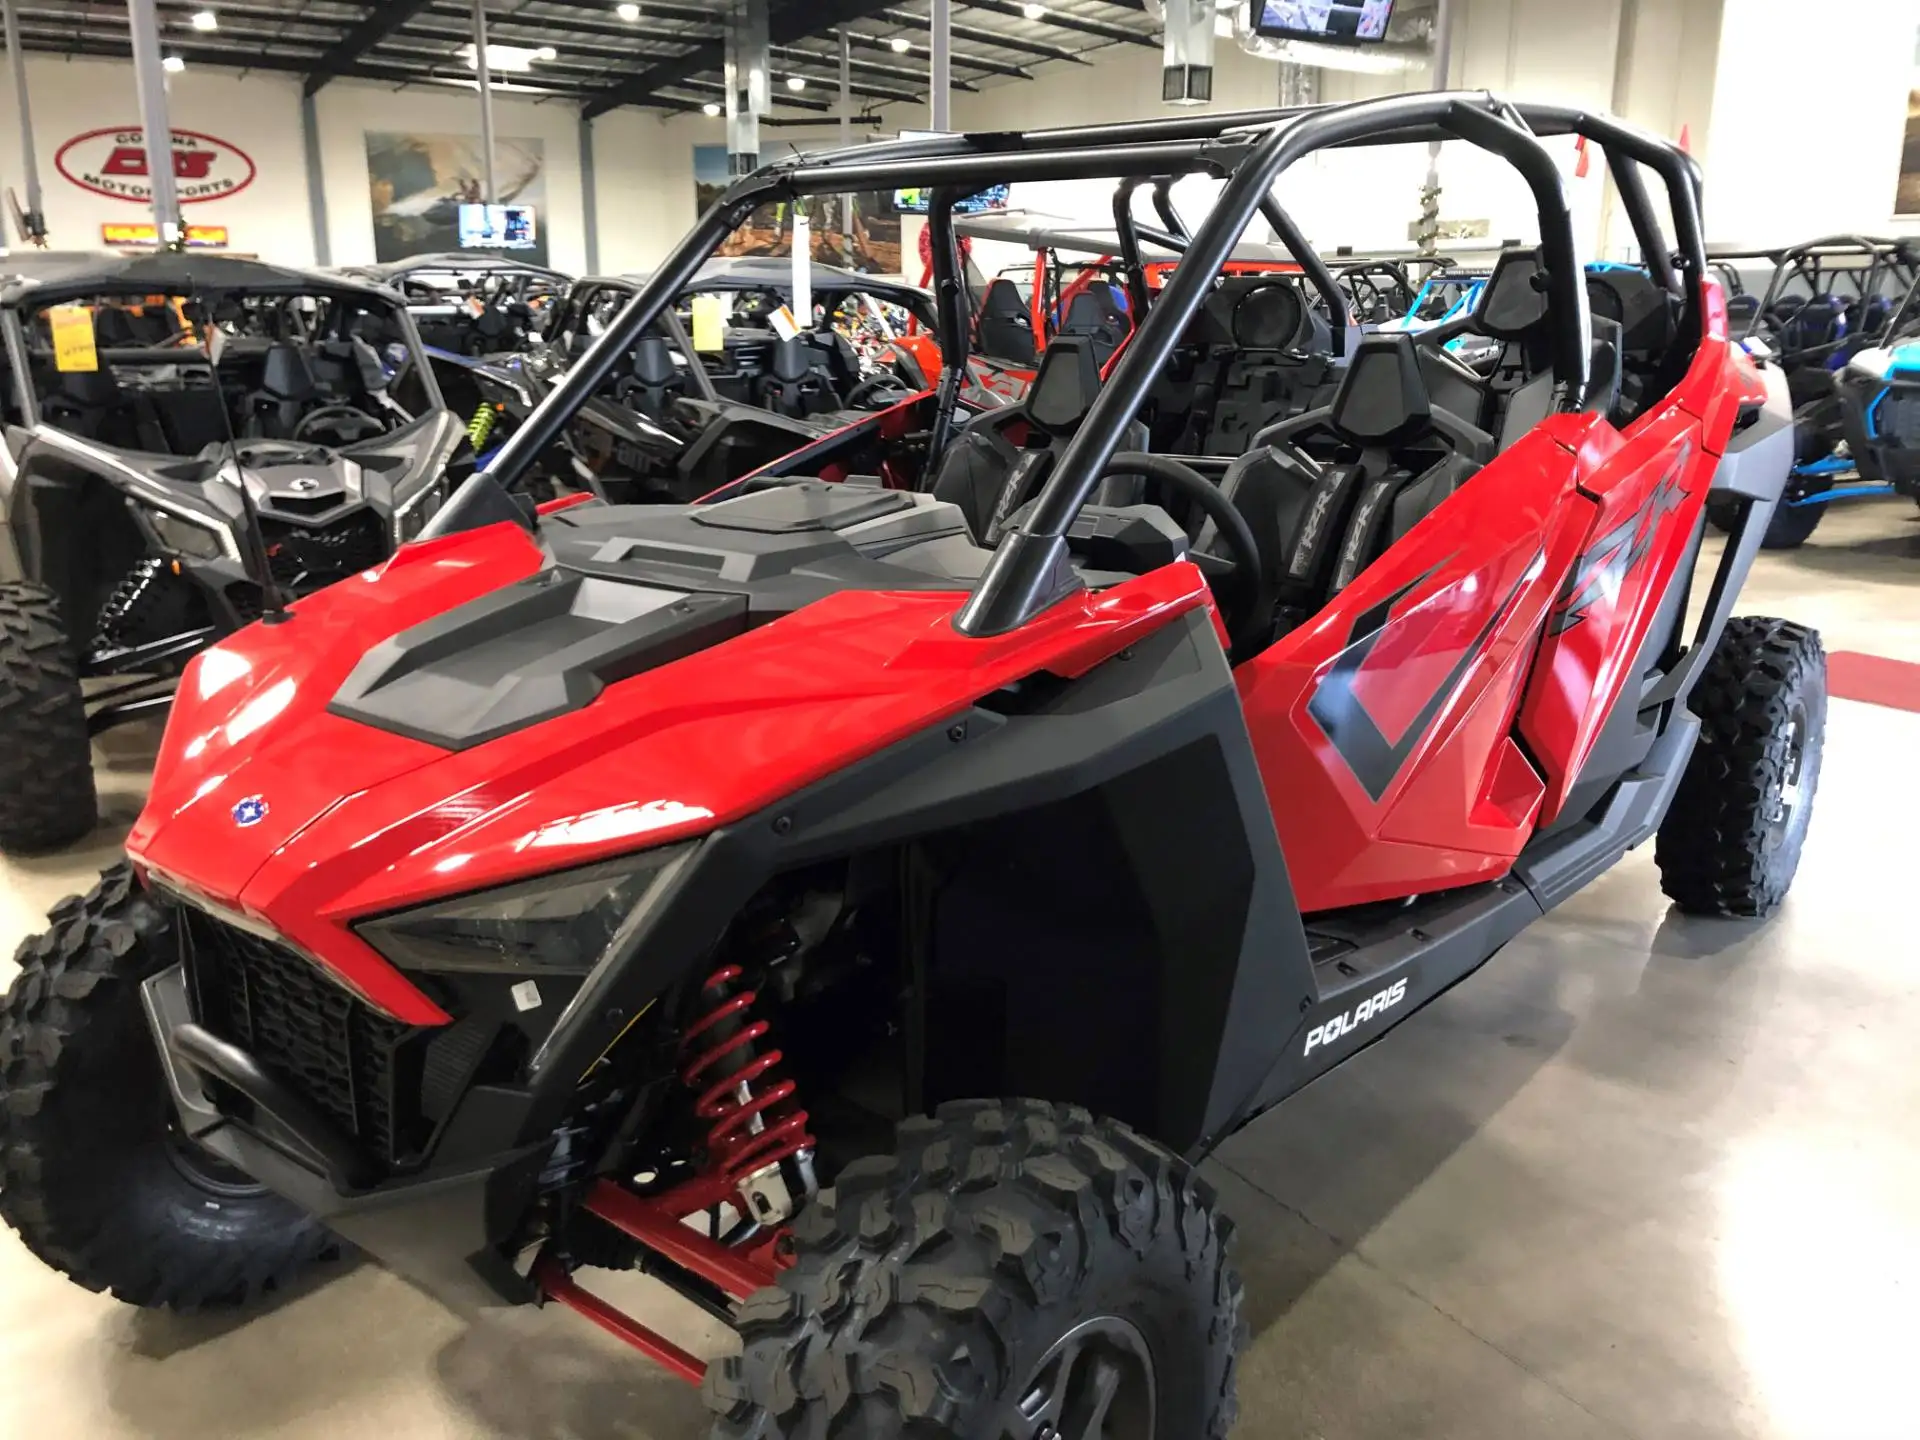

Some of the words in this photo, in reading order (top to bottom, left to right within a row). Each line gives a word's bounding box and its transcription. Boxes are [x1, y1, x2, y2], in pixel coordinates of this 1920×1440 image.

[115, 133, 197, 147] CONA
[1301, 491, 1334, 549] RZR
[1303, 976, 1408, 1056] POLARIS
